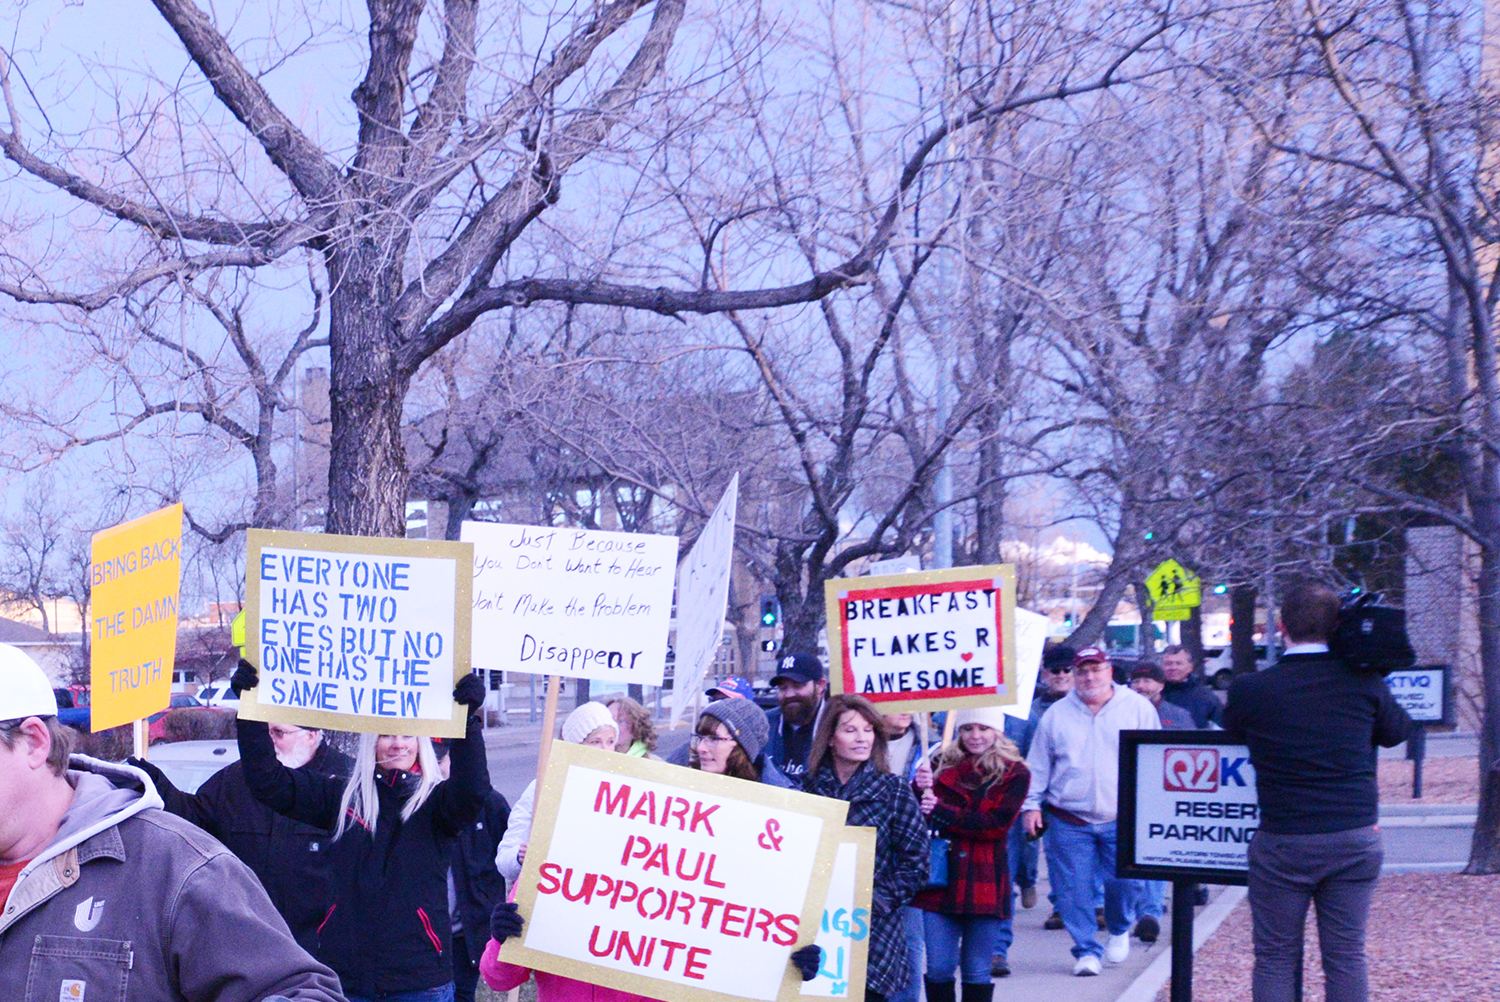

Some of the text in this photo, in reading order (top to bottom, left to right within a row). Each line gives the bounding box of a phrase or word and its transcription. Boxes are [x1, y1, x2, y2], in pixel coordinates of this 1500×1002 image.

[92, 537, 181, 586] BRING BACK
[568, 531, 646, 554] Because
[260, 553, 410, 591] EVERYONE
[565, 558, 602, 574] Want
[608, 559, 622, 575] to
[624, 558, 662, 578] Hear
[95, 593, 178, 640] THE DAMN
[272, 587, 397, 623] HAS TWO
[565, 596, 585, 617] the
[591, 593, 651, 618] Problem
[845, 589, 996, 621] BREAKFAST
[261, 618, 443, 659] EYES BUT NO
[520, 633, 643, 671] Disappear
[854, 631, 957, 657] FLAKES
[975, 627, 990, 648] R
[109, 657, 163, 694] TRUTH
[263, 645, 431, 687] ONE HAS THE
[863, 667, 985, 694] AWESOME
[271, 678, 422, 718] SAME VIEW
[594, 780, 785, 852] MARK &
[1175, 801, 1258, 820] RESER
[621, 835, 726, 889] PAUL
[536, 863, 801, 947] SUPPORTERS
[588, 925, 712, 981] UNITE
